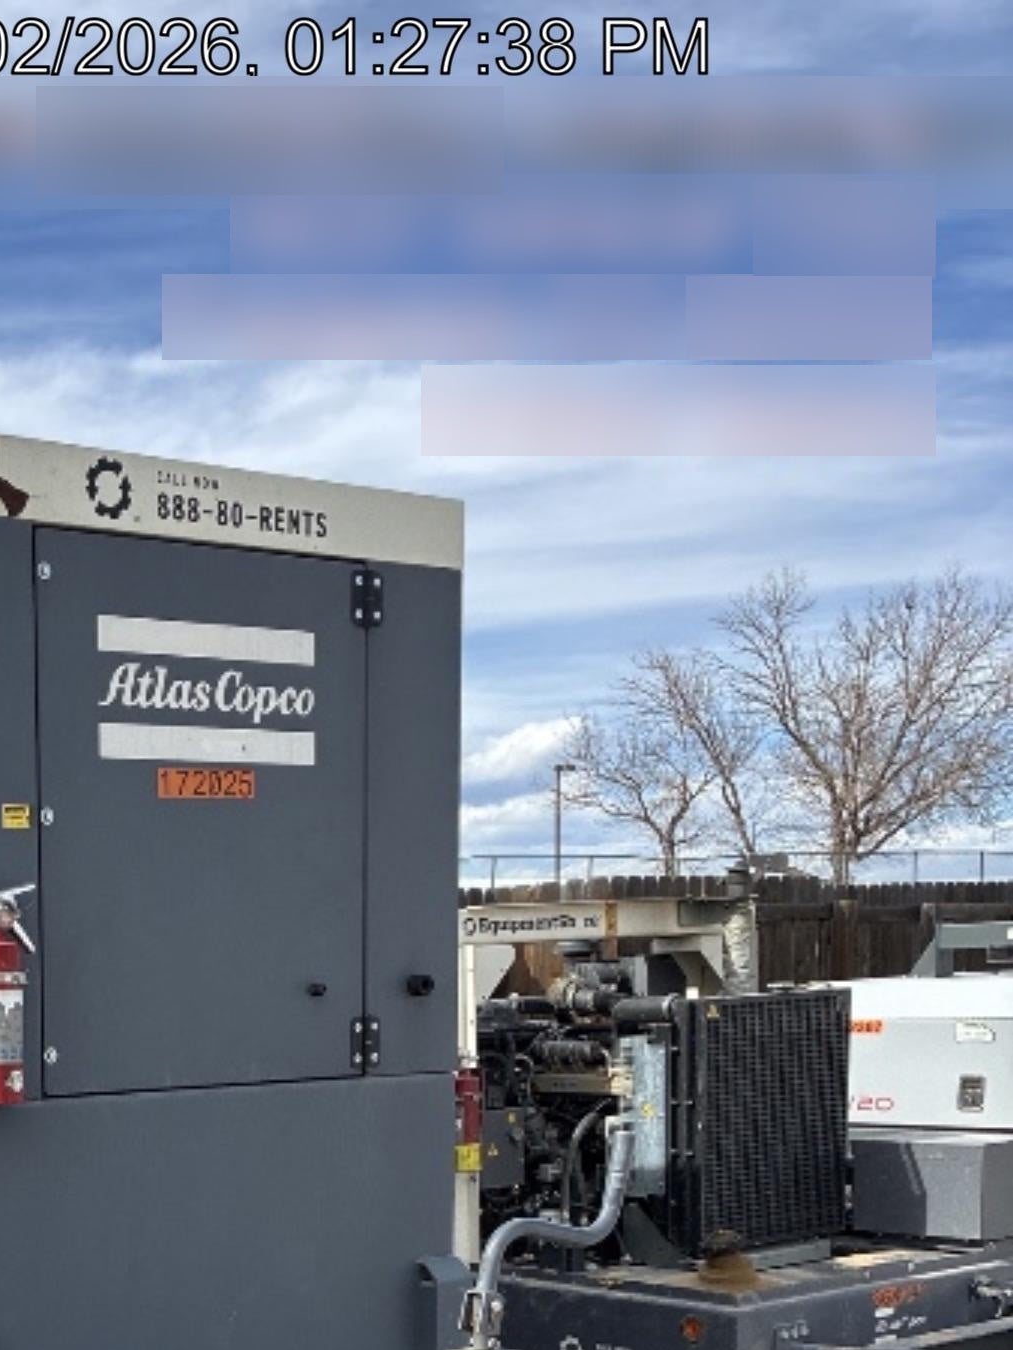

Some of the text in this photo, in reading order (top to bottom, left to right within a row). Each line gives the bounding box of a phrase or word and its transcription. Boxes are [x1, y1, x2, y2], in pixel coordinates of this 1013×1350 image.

[157, 491, 328, 538] 888-80-RENTS
[98, 661, 315, 724] Atlas Copco
[160, 769, 253, 797] 172025
